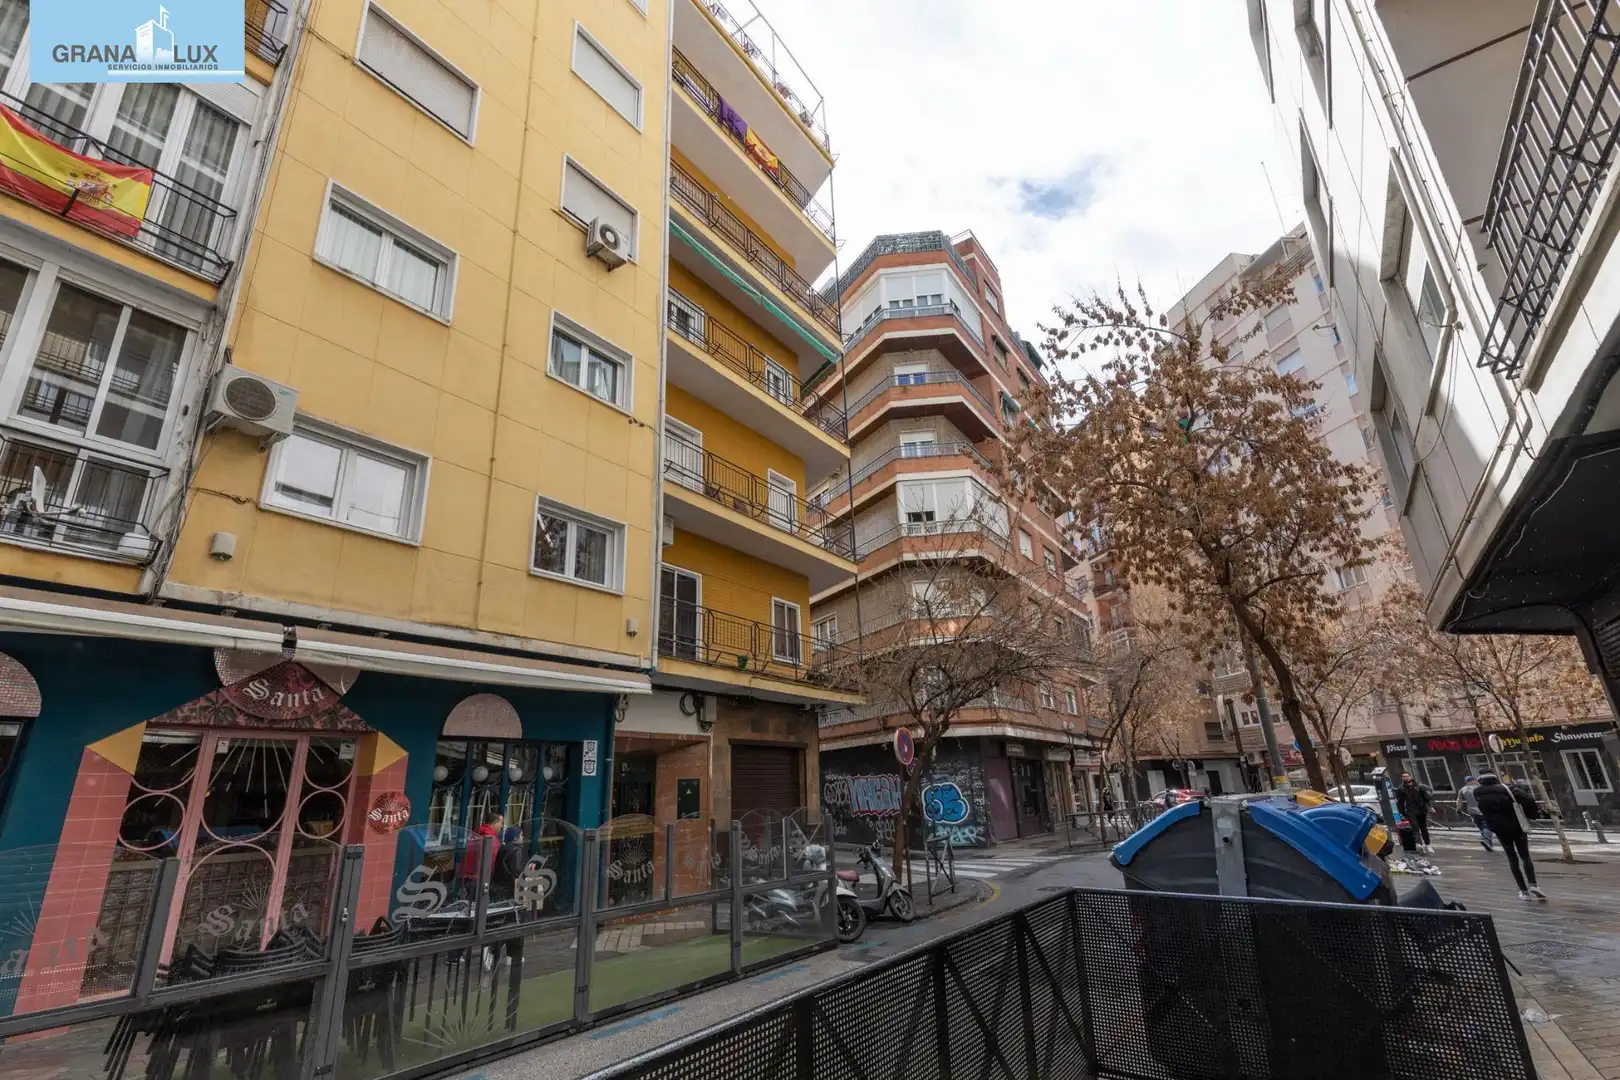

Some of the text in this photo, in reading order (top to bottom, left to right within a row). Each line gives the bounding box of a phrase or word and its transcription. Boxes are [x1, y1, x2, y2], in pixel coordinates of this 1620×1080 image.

[242, 678, 325, 708] Santa
[1551, 731, 1603, 743] Shawarm
[367, 807, 410, 824] Santa
[514, 854, 557, 905] S
[606, 859, 656, 885] Santa
[391, 864, 448, 923] S
[198, 901, 314, 942] Santa
